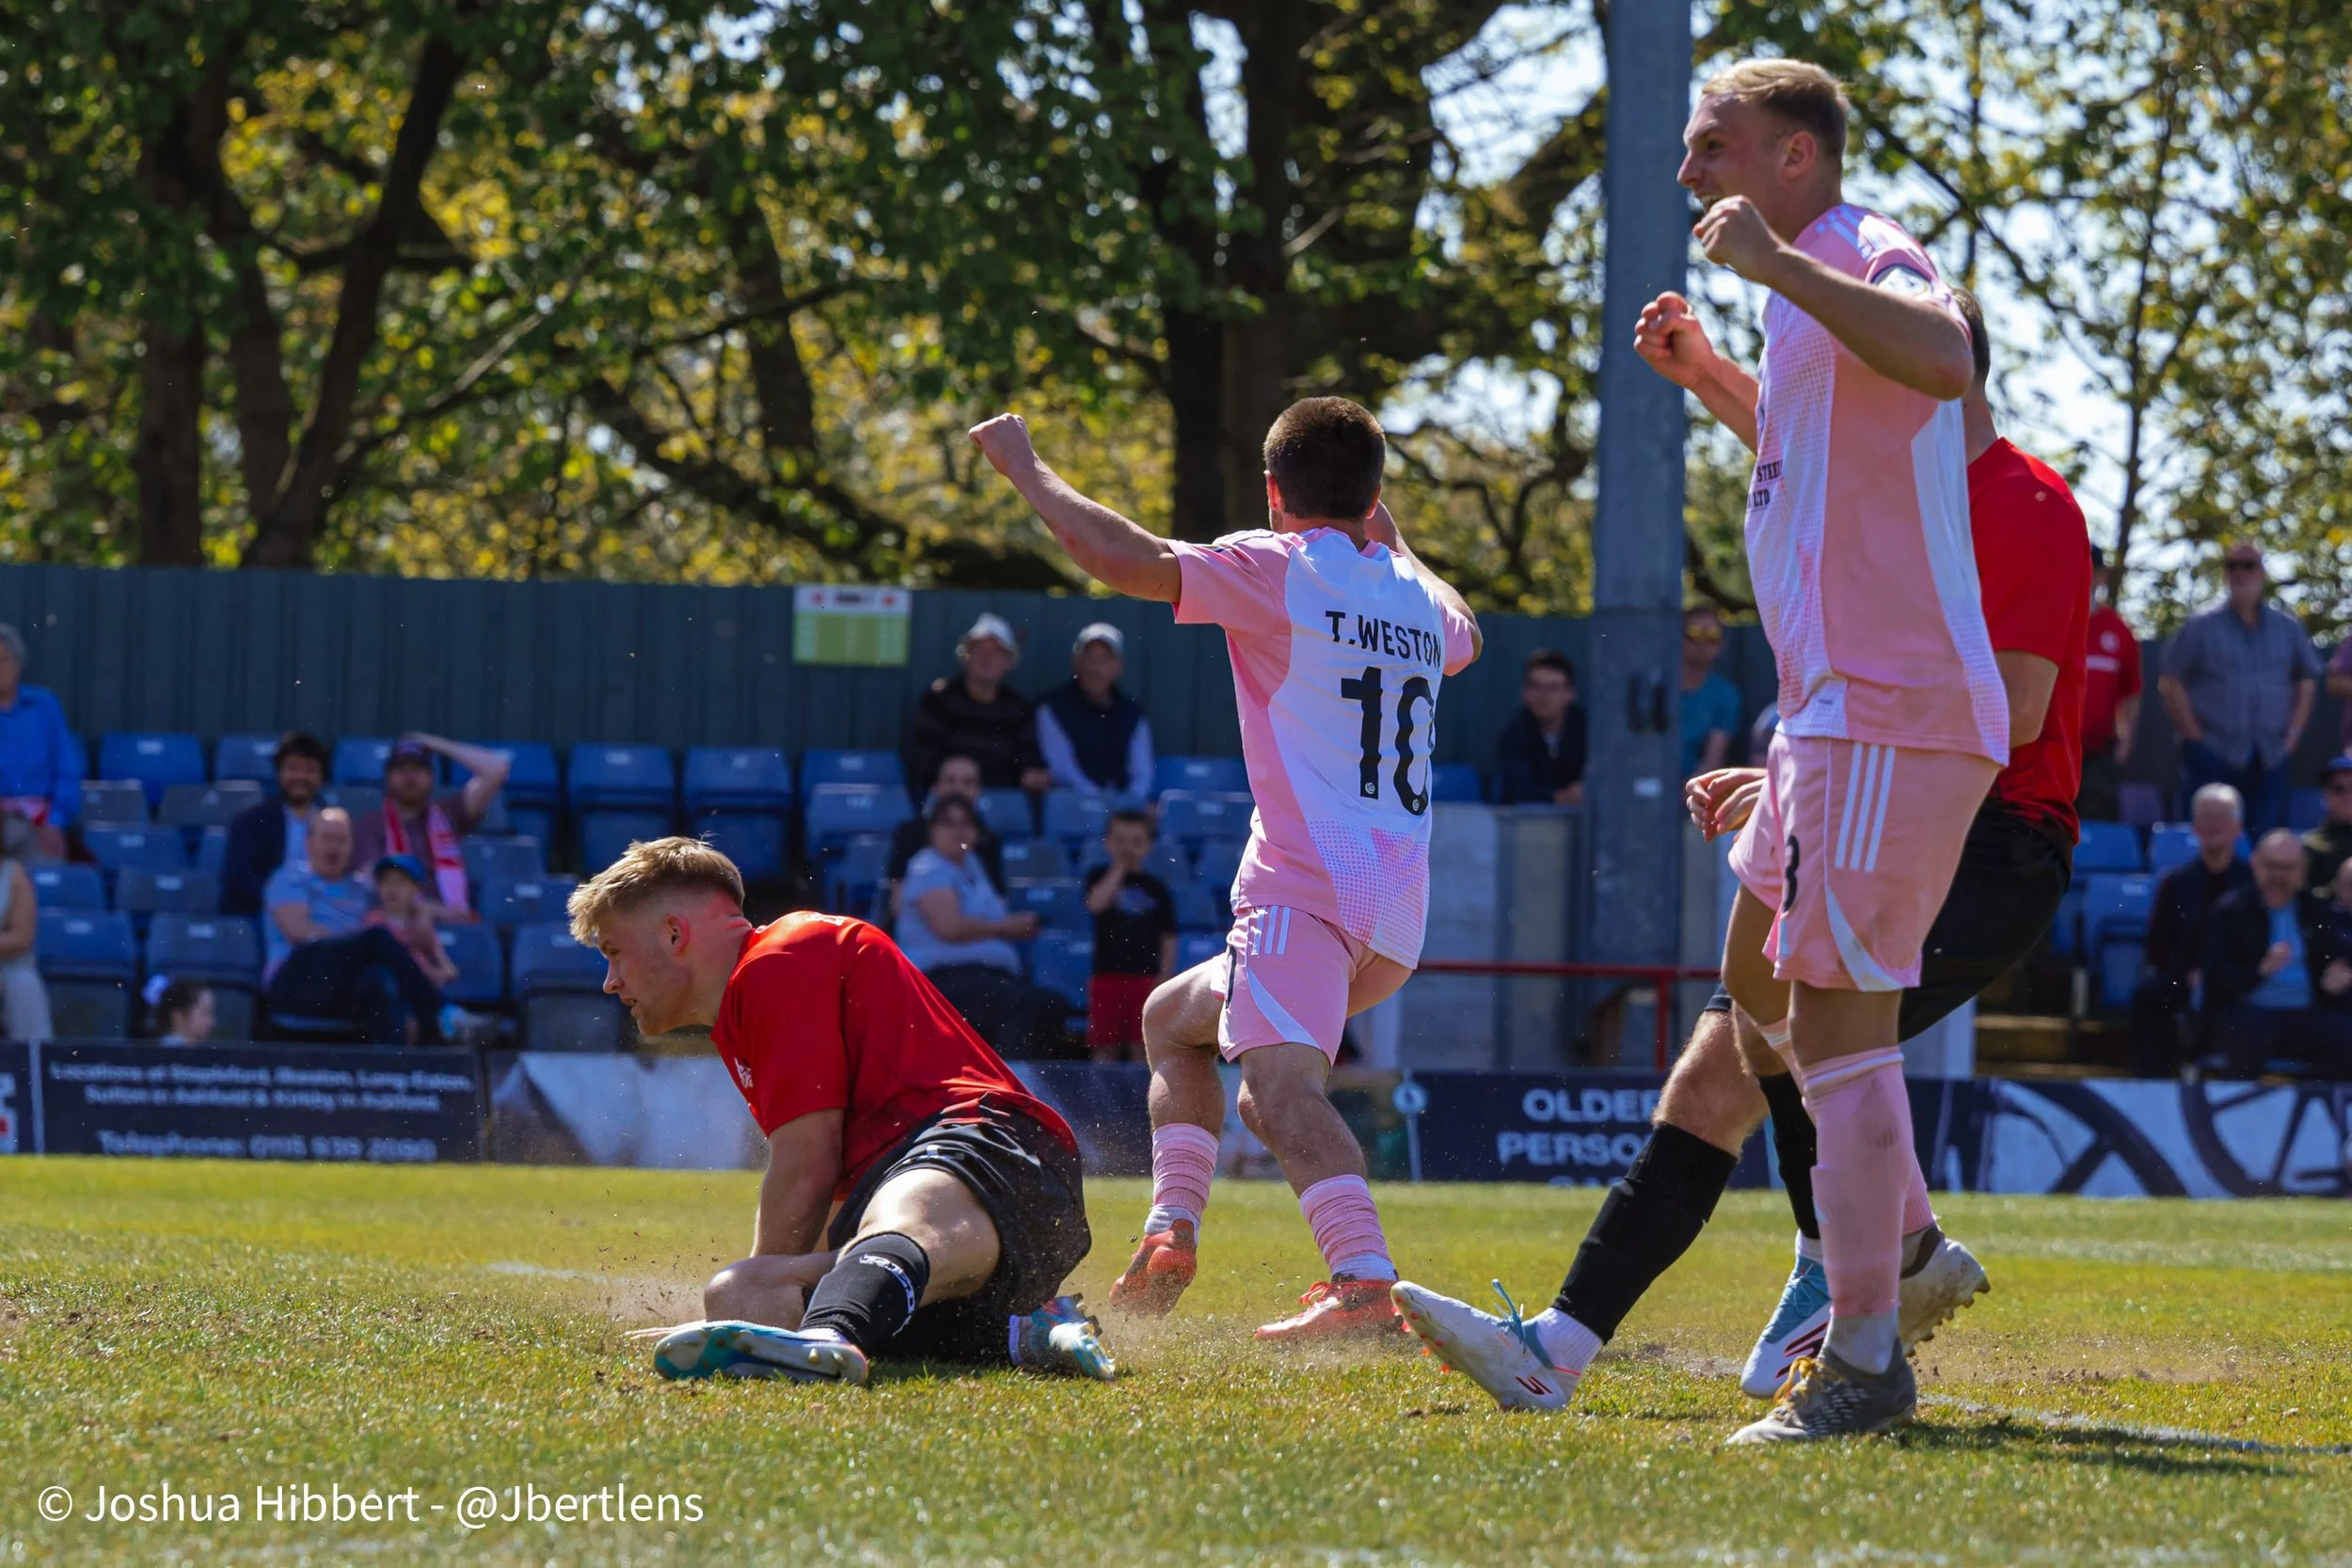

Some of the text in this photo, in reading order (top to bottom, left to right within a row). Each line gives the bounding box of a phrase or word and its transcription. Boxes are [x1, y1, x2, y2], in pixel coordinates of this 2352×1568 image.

[1326, 610, 1441, 670] T.WESTON
[1341, 665, 1437, 816] 10
[1497, 1132, 1651, 1166] PERSO
